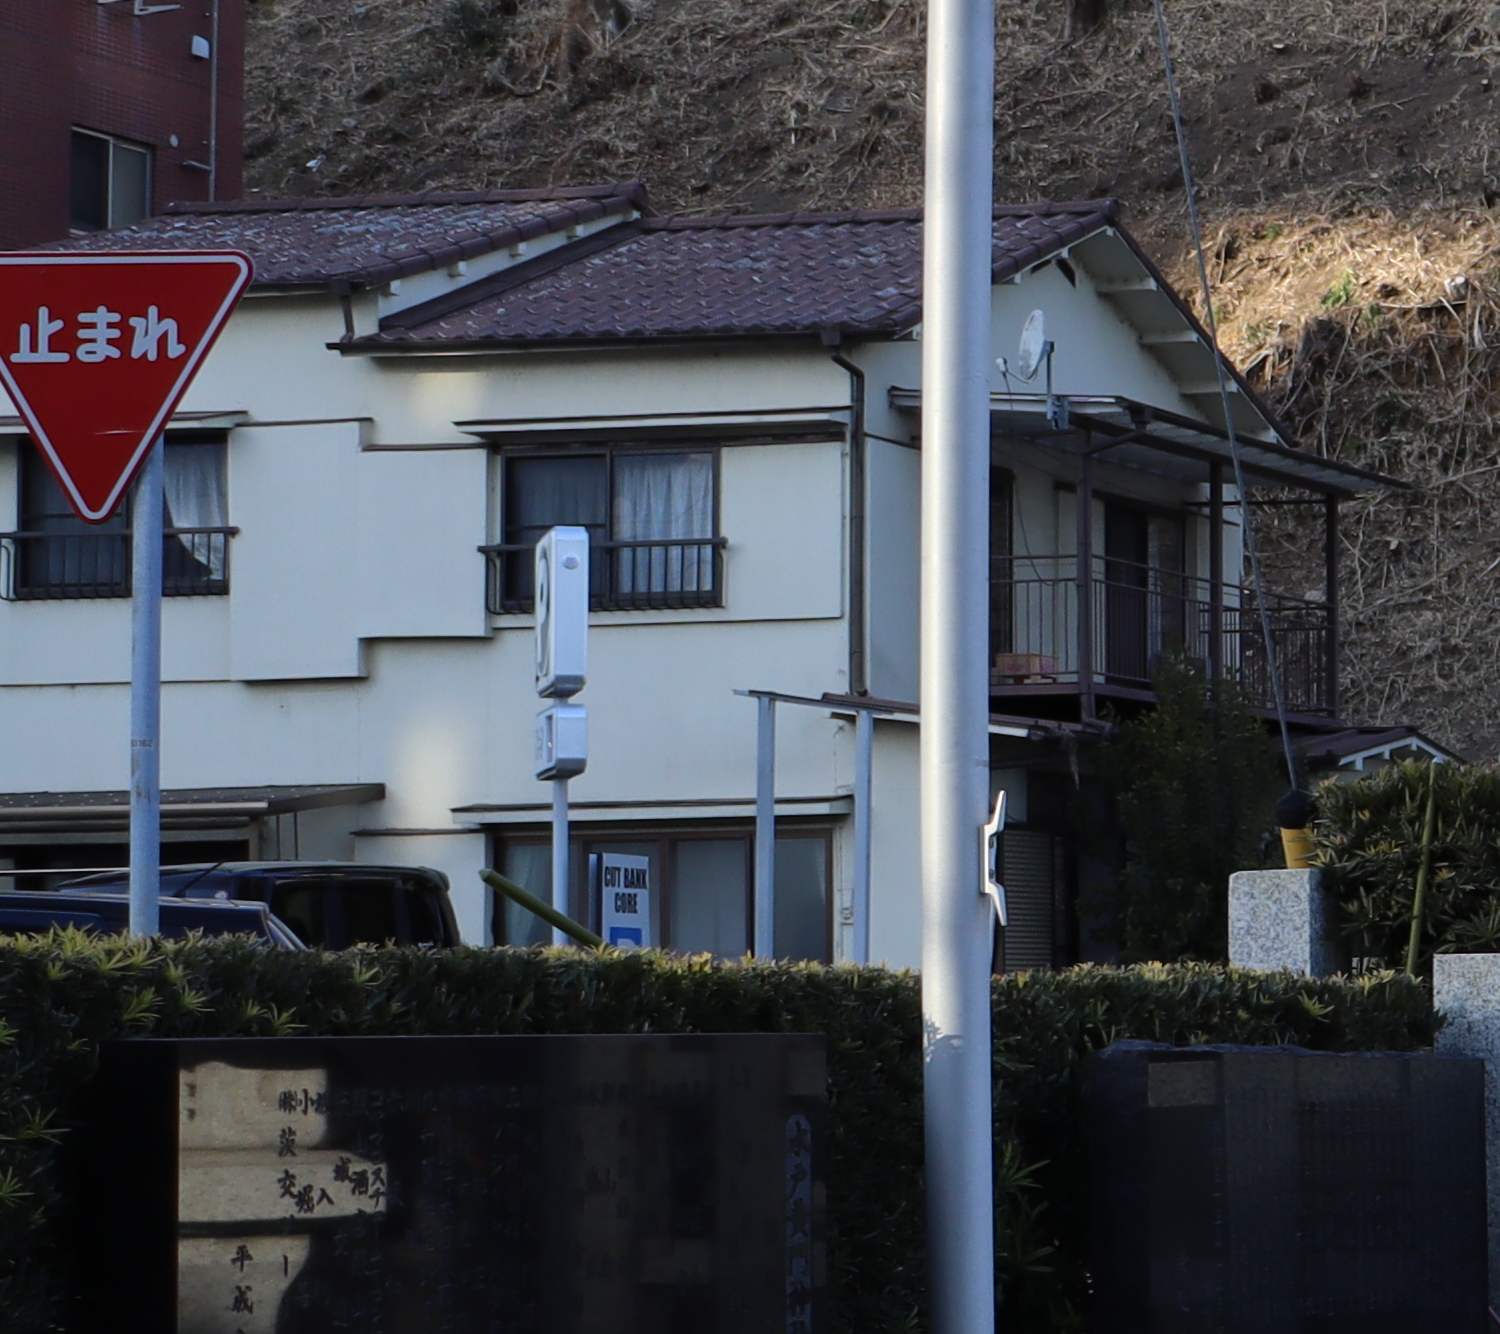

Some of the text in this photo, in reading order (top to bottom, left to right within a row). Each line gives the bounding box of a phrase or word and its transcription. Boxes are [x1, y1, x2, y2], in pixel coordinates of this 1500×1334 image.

[10, 305, 187, 366] 止まれ
[604, 865, 648, 891] CUT BANK
[614, 891, 639, 915] CORE
